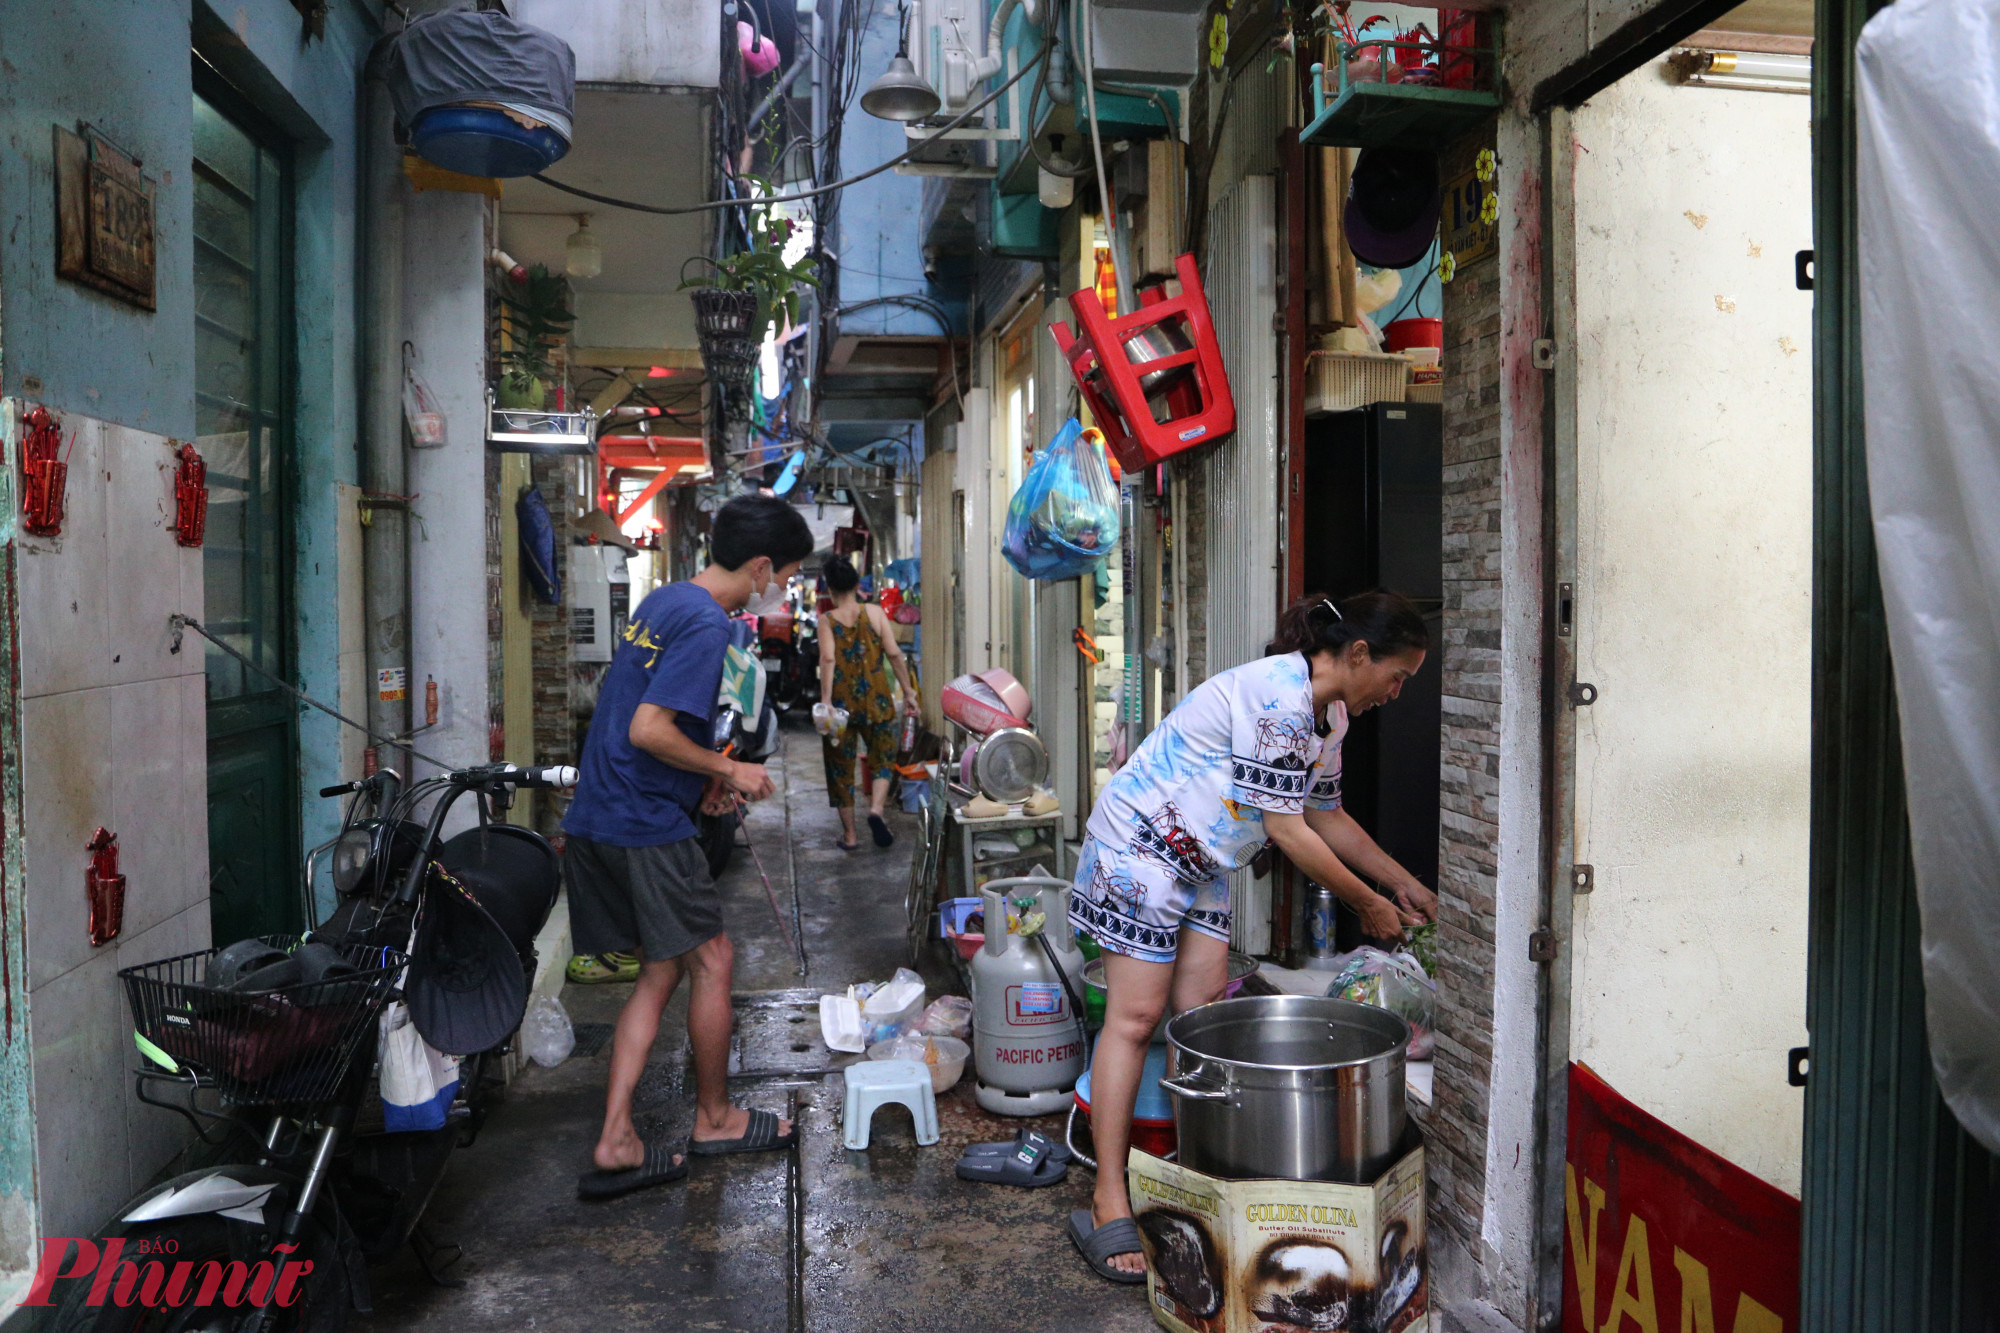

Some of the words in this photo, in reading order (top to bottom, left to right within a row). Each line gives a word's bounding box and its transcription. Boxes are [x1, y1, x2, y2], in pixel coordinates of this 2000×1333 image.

[1451, 178, 1482, 232] 19
[166, 1014, 191, 1025] HONDA
[996, 1047, 1044, 1065] PACIFIC
[1047, 1041, 1081, 1063] PETRO
[1246, 1203, 1308, 1223] GOLDEN
[1310, 1205, 1359, 1228] OLINA
[1302, 1226, 1346, 1236] Substitute
